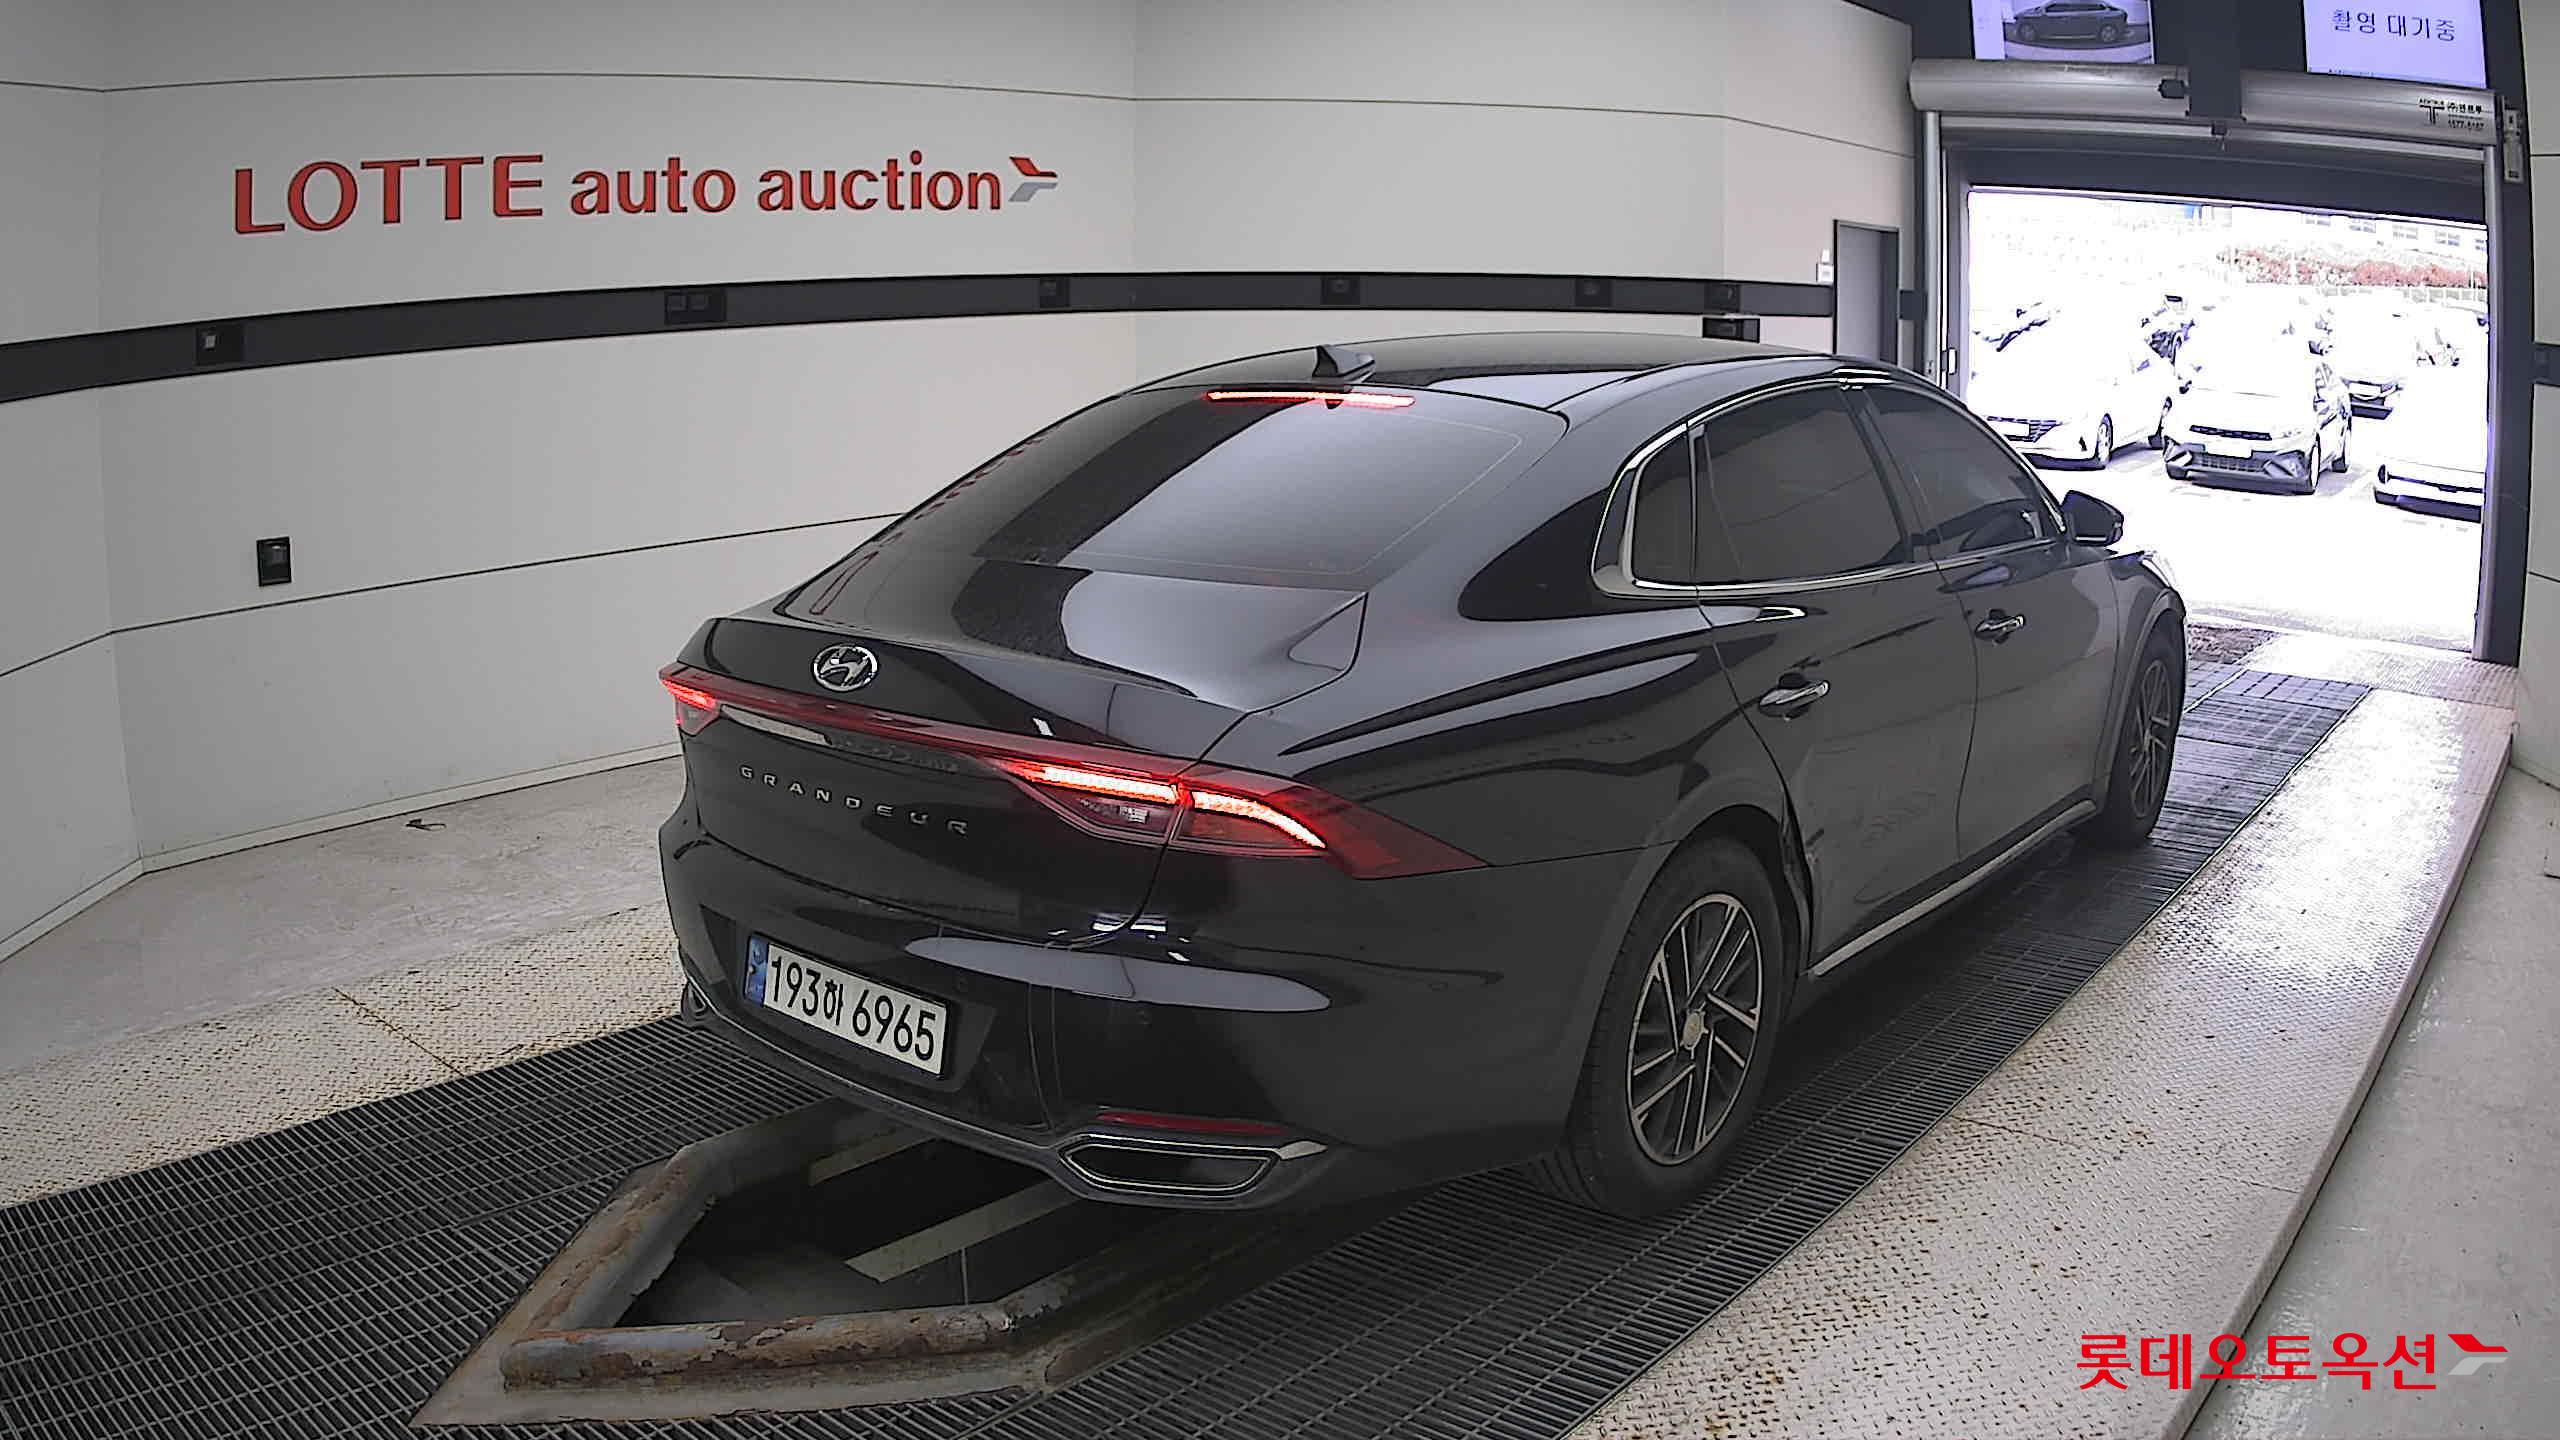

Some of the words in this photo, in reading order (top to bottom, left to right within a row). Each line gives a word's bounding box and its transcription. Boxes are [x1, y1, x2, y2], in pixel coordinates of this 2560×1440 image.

[2332, 9, 2376, 34] 촬영
[234, 154, 544, 235] LOTTE
[569, 156, 737, 215] auto
[757, 150, 1002, 212] auction
[740, 766, 968, 835] GRANDEUR
